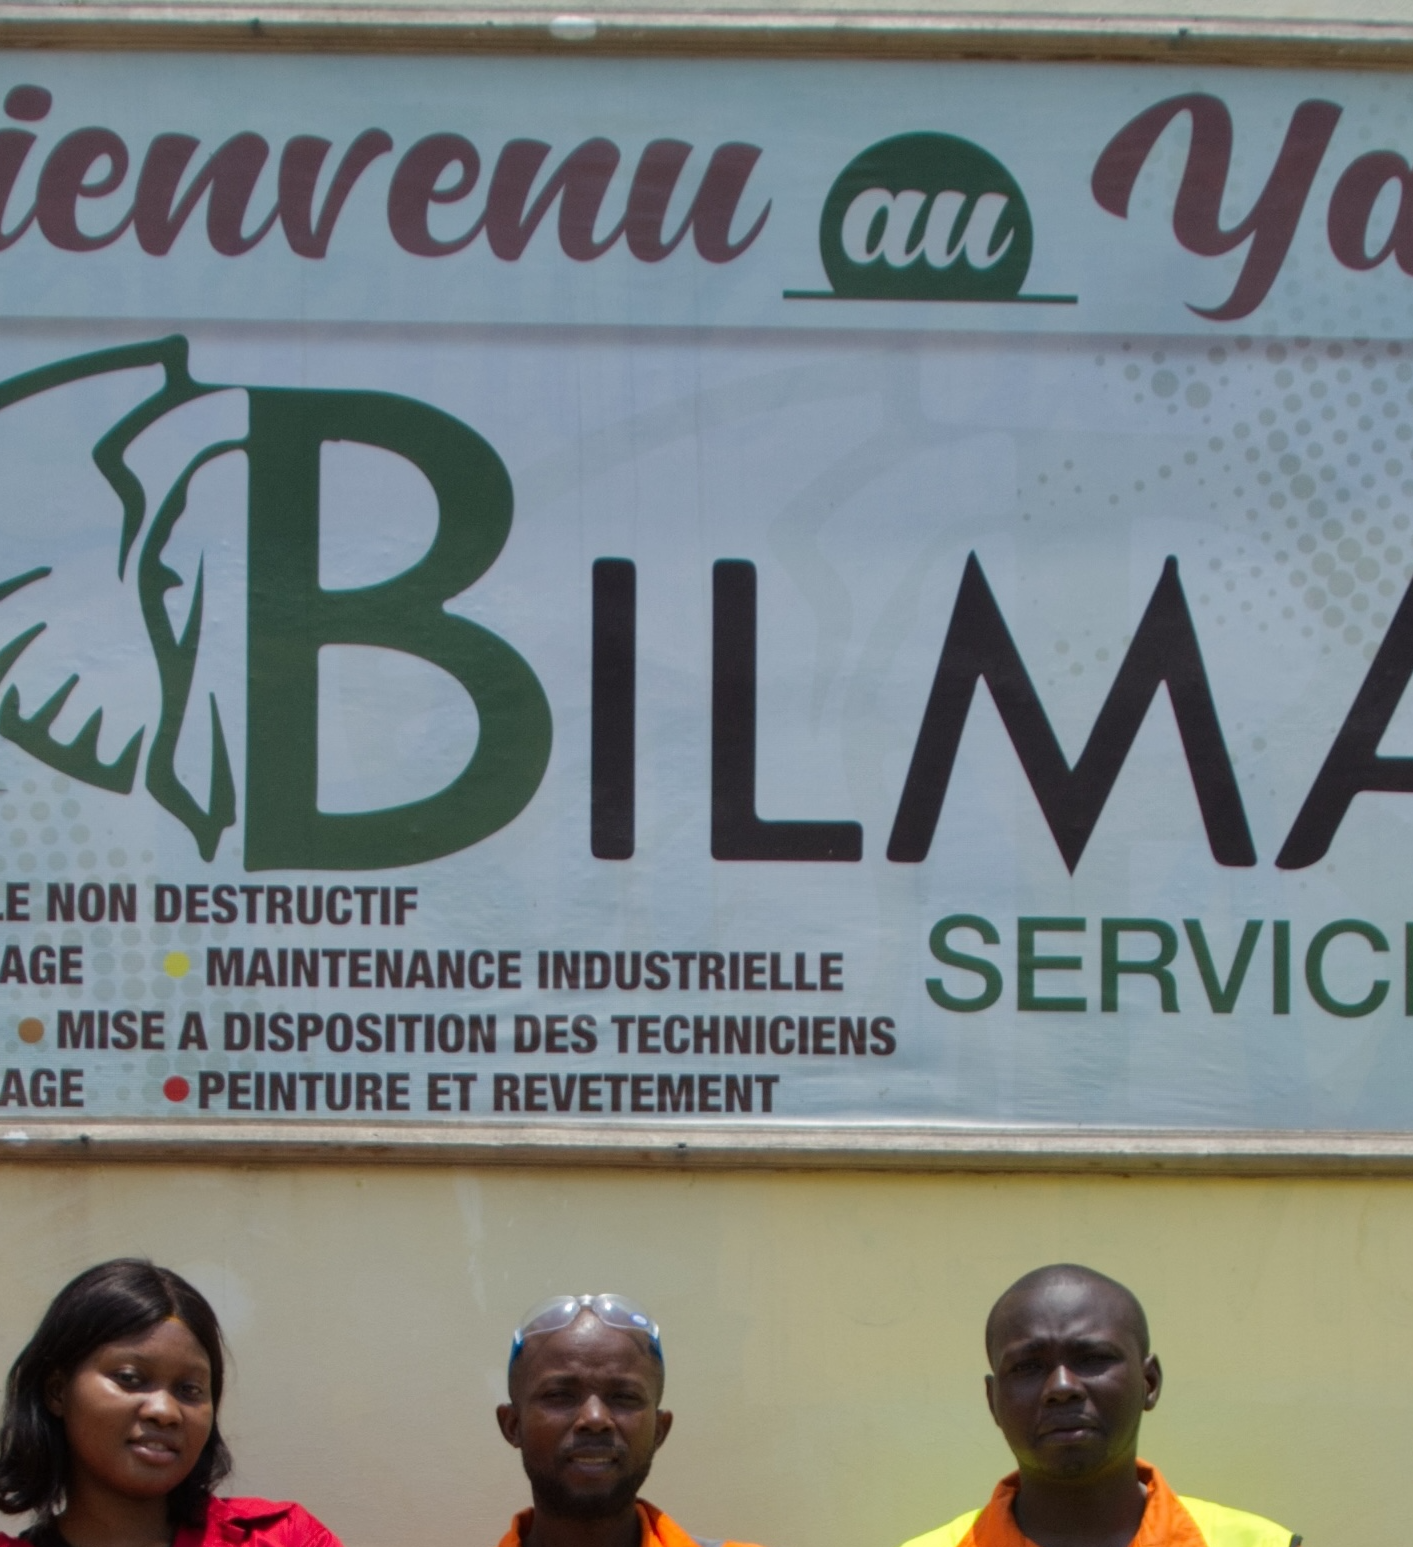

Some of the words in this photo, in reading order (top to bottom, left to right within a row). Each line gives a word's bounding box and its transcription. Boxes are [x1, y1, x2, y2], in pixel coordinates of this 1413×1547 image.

[840, 186, 1015, 270] au
[45, 881, 138, 924] NON
[153, 882, 419, 927] DESTRUCTIF
[205, 946, 523, 991] MAINTENANCE
[537, 949, 845, 993] INDUSTRIELLE
[56, 1008, 166, 1052] MISE
[176, 1010, 210, 1052] A
[222, 1010, 498, 1055] DISPOSITION
[512, 1013, 599, 1055] DES
[609, 1014, 898, 1058] TECHNICIENS
[197, 1069, 411, 1113] PEINTURE
[426, 1071, 479, 1113] ET
[492, 1072, 781, 1114] REVETEMENT
